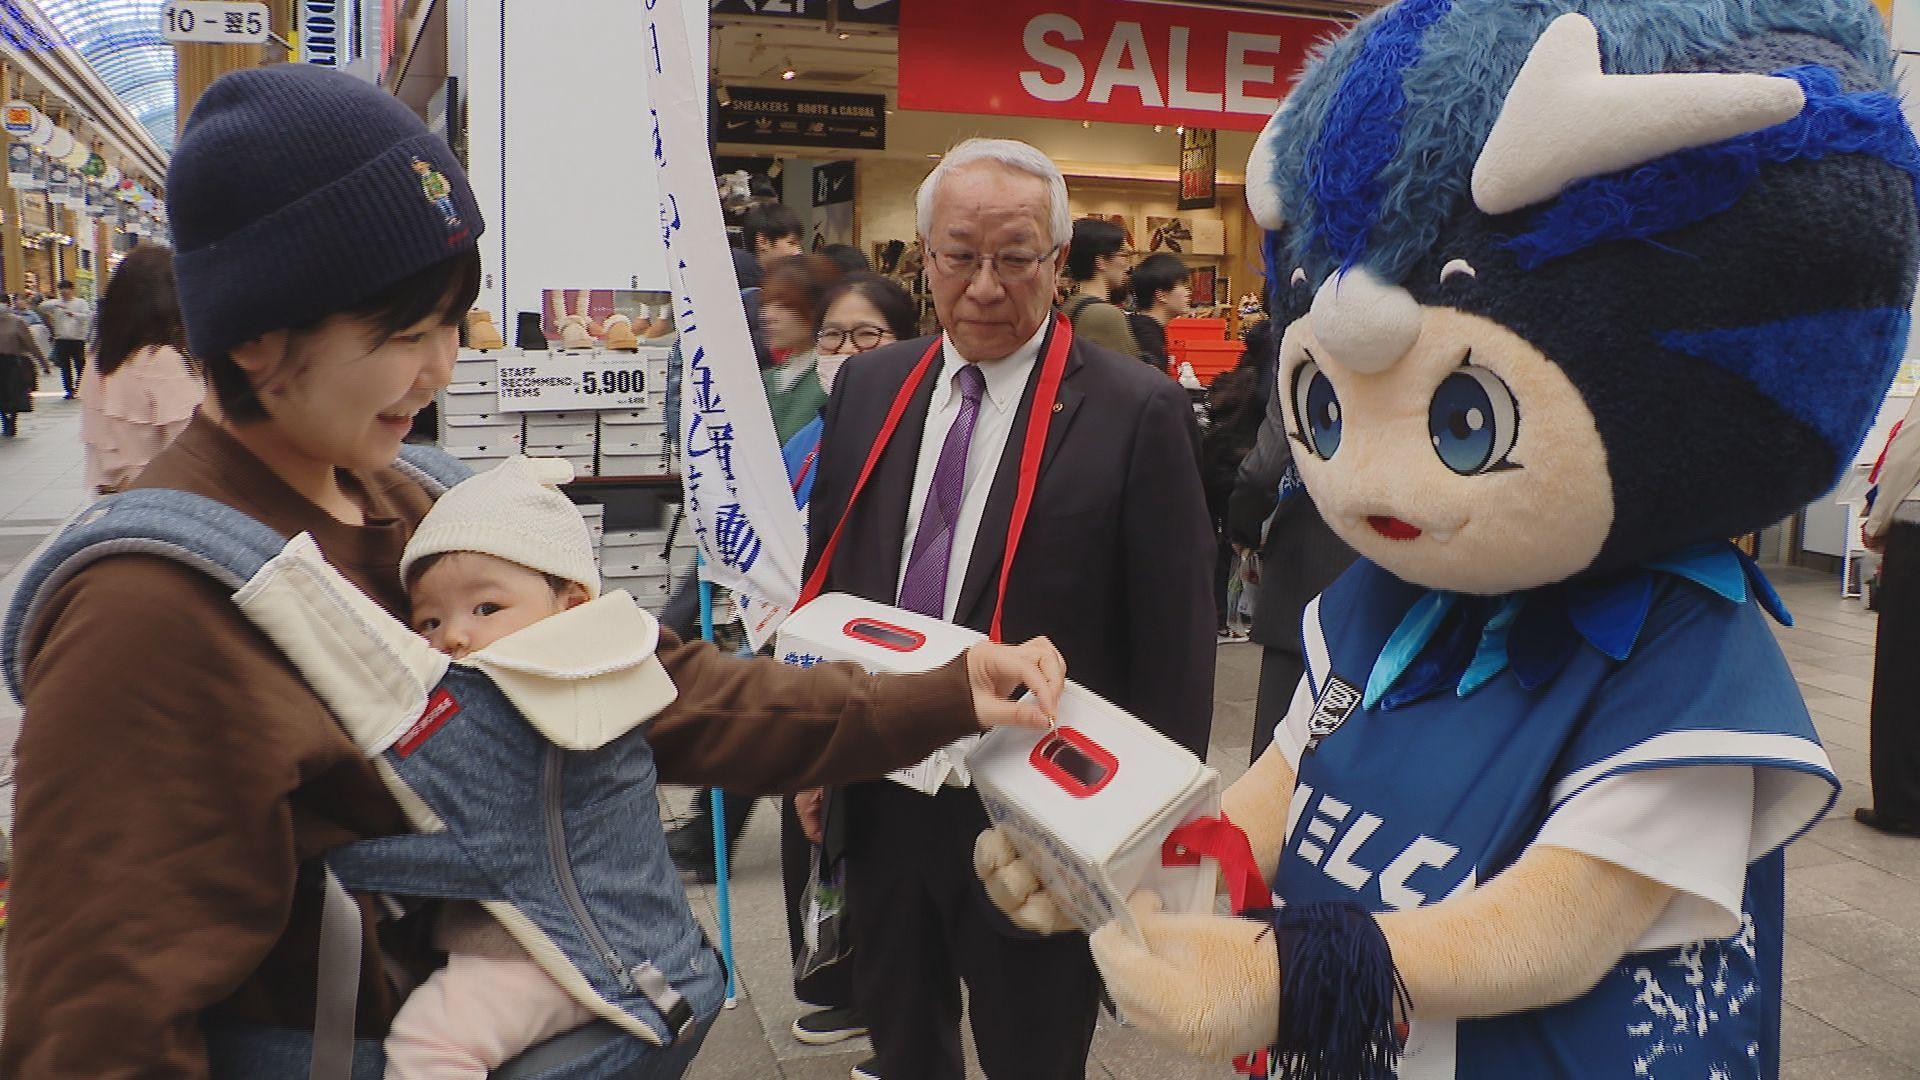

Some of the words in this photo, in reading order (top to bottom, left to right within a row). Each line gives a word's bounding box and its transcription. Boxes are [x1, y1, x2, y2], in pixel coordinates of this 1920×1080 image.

[166, 7, 195, 33] 10
[1018, 12, 1281, 115] SALE
[732, 99, 790, 114] SNEAKERS
[797, 103, 828, 116] BOOTS
[840, 105, 875, 118] CASUAL
[500, 367, 537, 378] STAFF
[501, 377, 572, 388] RECOMMEND
[502, 387, 541, 398] ITEMS
